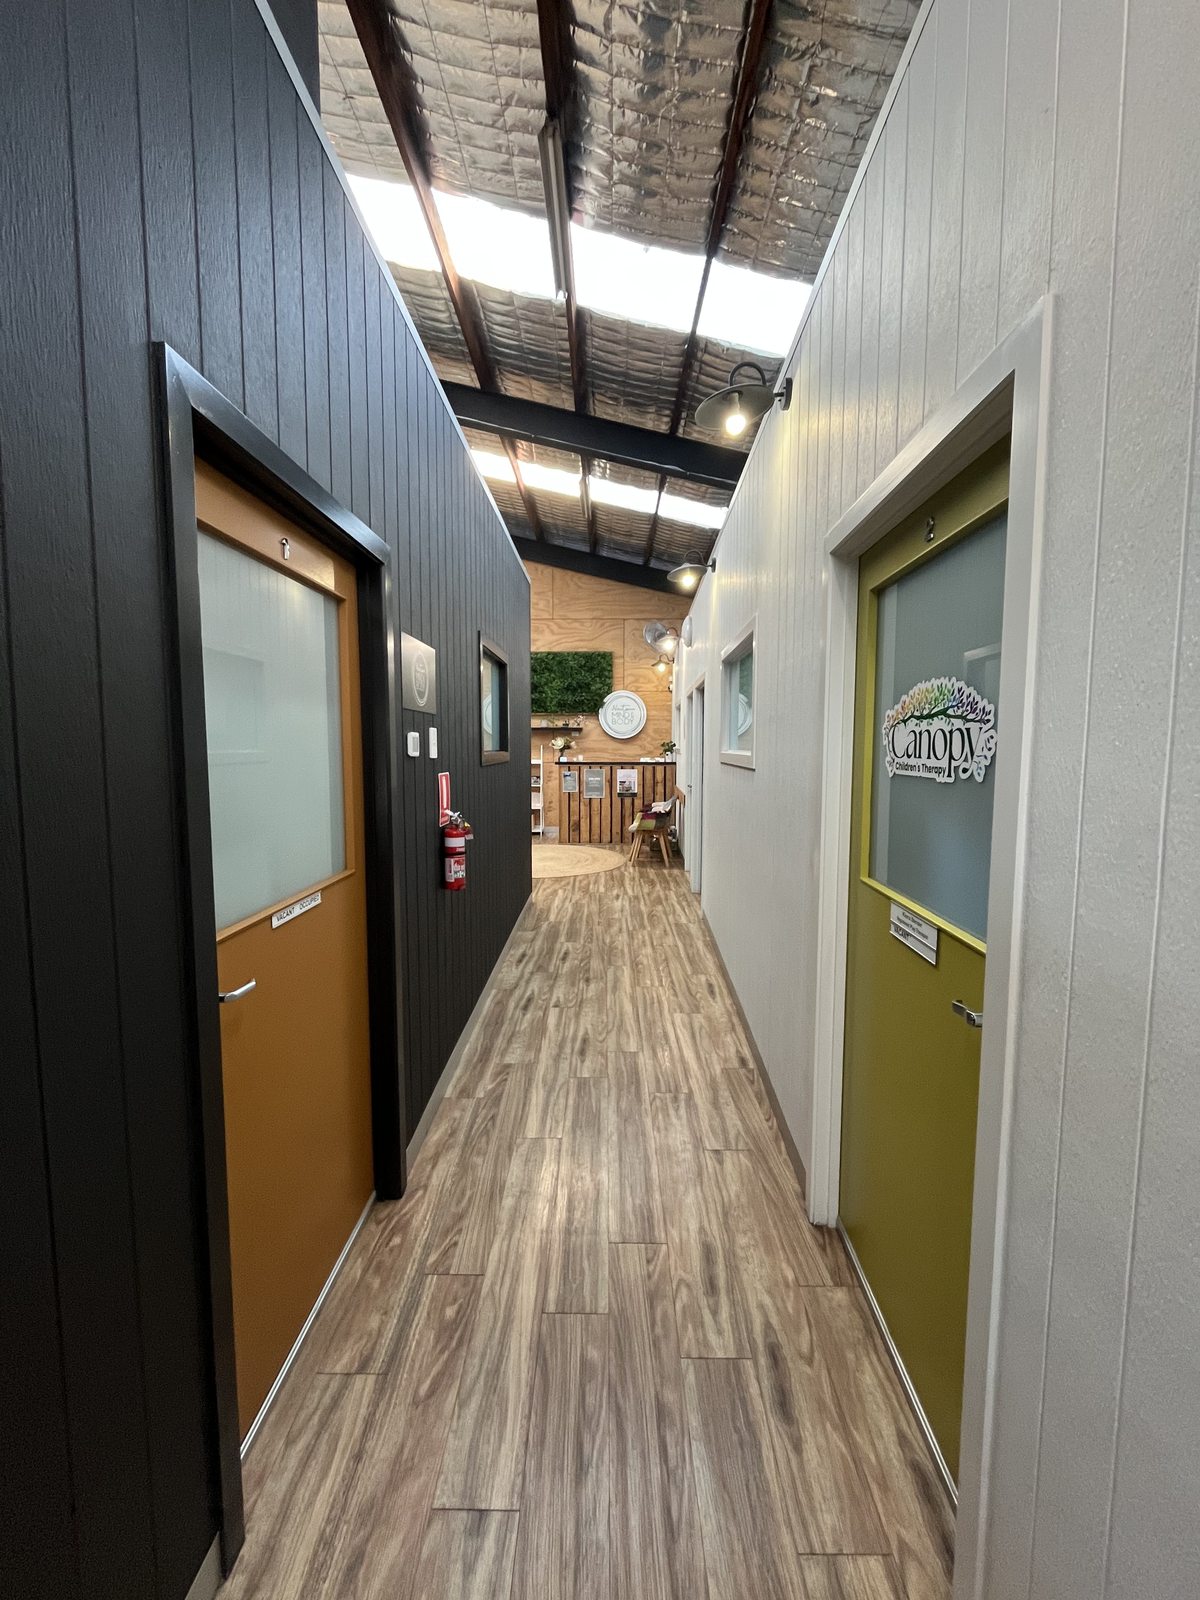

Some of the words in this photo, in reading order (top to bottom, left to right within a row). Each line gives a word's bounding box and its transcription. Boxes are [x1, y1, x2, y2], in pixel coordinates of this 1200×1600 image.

[891, 722, 983, 778] Canopy
[895, 761, 921, 773] Children's
[921, 763, 946, 778] Therapy
[276, 906, 295, 922] VACANT
